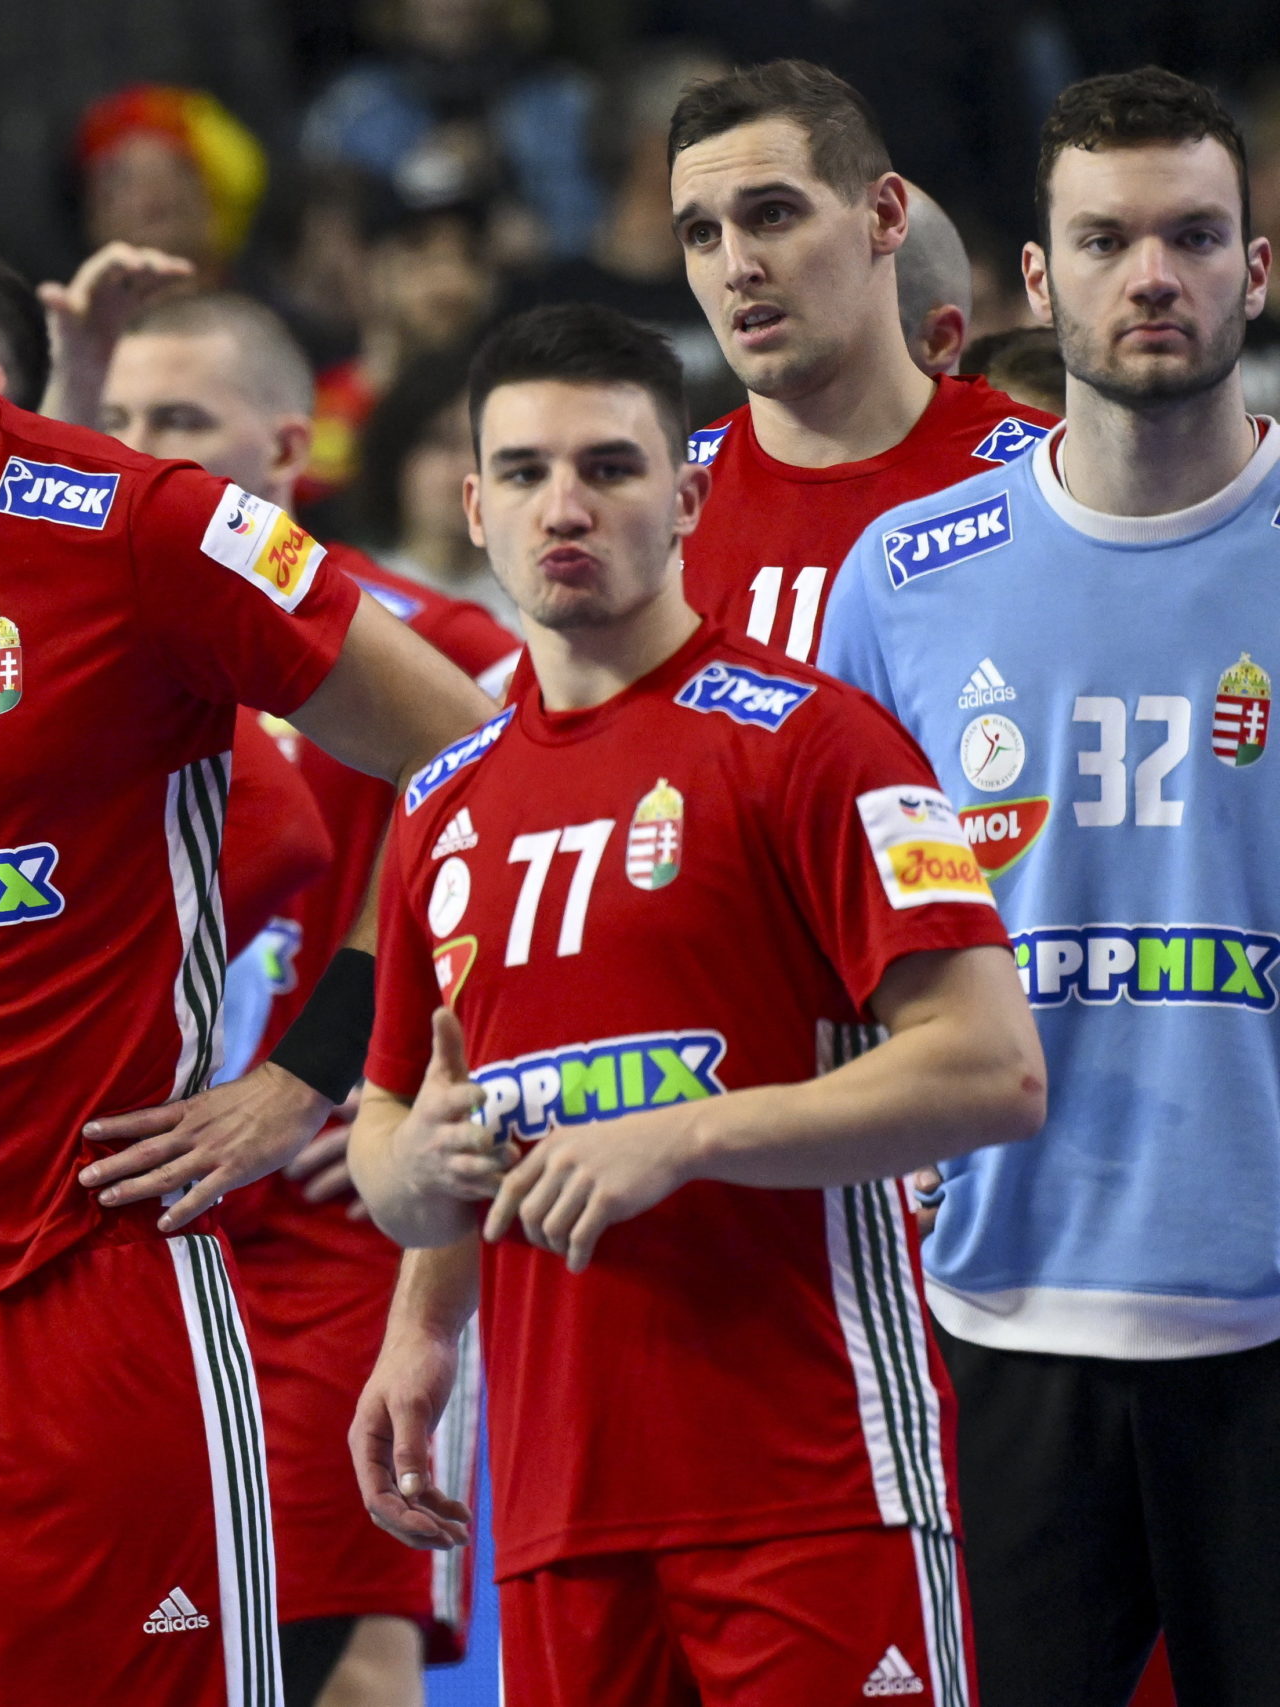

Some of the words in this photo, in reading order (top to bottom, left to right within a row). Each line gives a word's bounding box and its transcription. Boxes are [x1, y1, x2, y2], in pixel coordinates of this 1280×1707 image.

[22, 477, 110, 514] JYSK
[268, 526, 310, 588] Jos
[912, 506, 1005, 561] JYSK
[746, 566, 828, 664] 11
[711, 677, 799, 715] JYSK
[958, 686, 1017, 709] adidas
[425, 718, 507, 785] JYSK
[1072, 695, 1191, 827] 32
[963, 810, 1021, 845] MOL
[505, 818, 617, 968] 77
[1014, 937, 1271, 1000] iPPMIX
[143, 1614, 210, 1634] adidas
[862, 1677, 924, 1697] adidas
